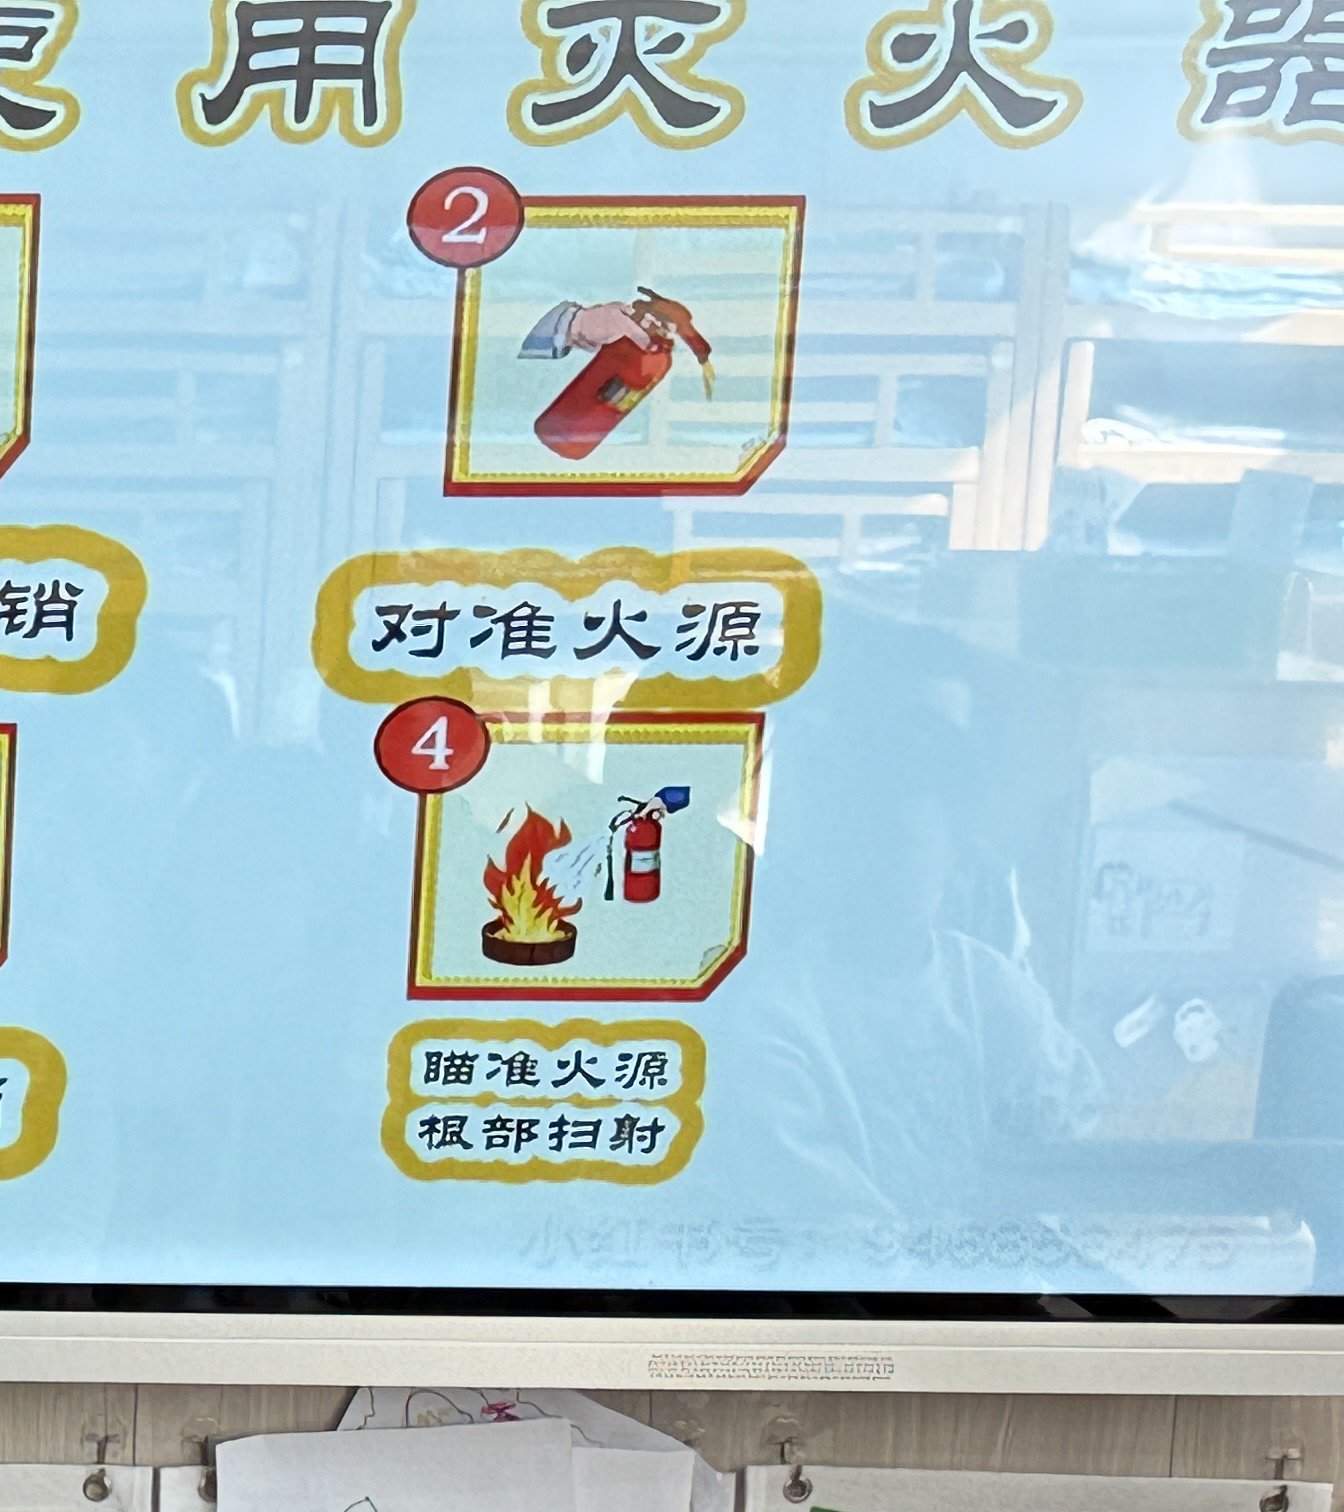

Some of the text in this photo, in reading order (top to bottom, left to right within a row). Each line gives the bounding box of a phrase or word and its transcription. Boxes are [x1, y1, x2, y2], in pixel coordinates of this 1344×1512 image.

[441, 186, 489, 245] 2
[371, 598, 762, 662] 对准火源
[411, 716, 455, 771] 4
[422, 1049, 669, 1091] 瞄准火源
[418, 1113, 667, 1155] 根部扫射
